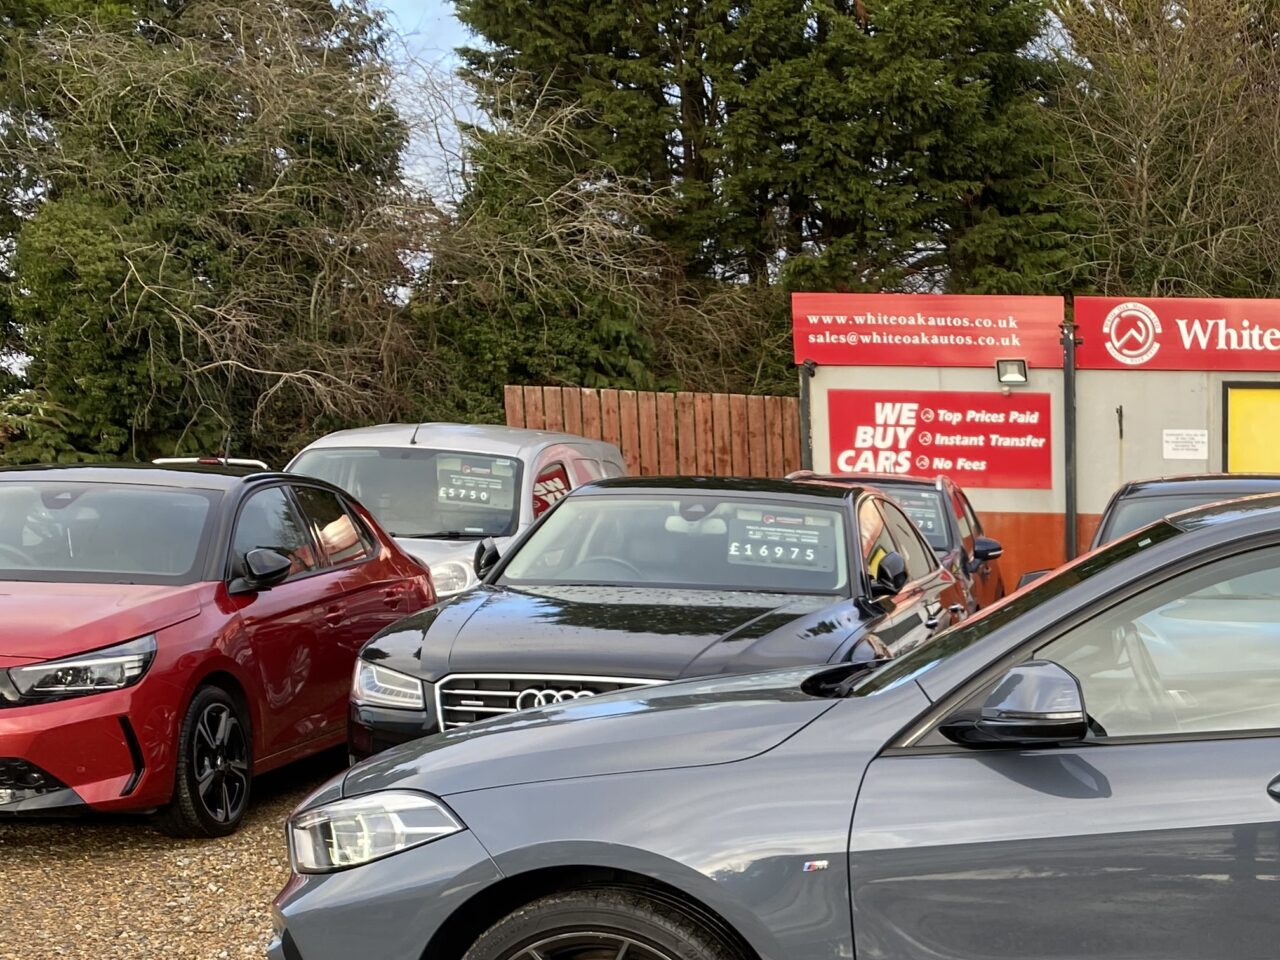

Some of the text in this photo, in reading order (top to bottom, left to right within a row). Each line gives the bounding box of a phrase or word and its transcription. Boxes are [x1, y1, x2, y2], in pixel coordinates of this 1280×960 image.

[807, 312, 1018, 328] www.whiteoakautos.co.uk
[808, 331, 1020, 347] sales@whiteoakautos.co.uk
[1176, 319, 1280, 350] White
[875, 403, 918, 425] WE
[938, 410, 1039, 424] Top Prices Paid
[855, 426, 915, 449] BUY
[935, 434, 1045, 447] Instant Transfer
[837, 450, 911, 473] CARS
[933, 458, 986, 470] No Fees
[728, 541, 815, 561] £16975
